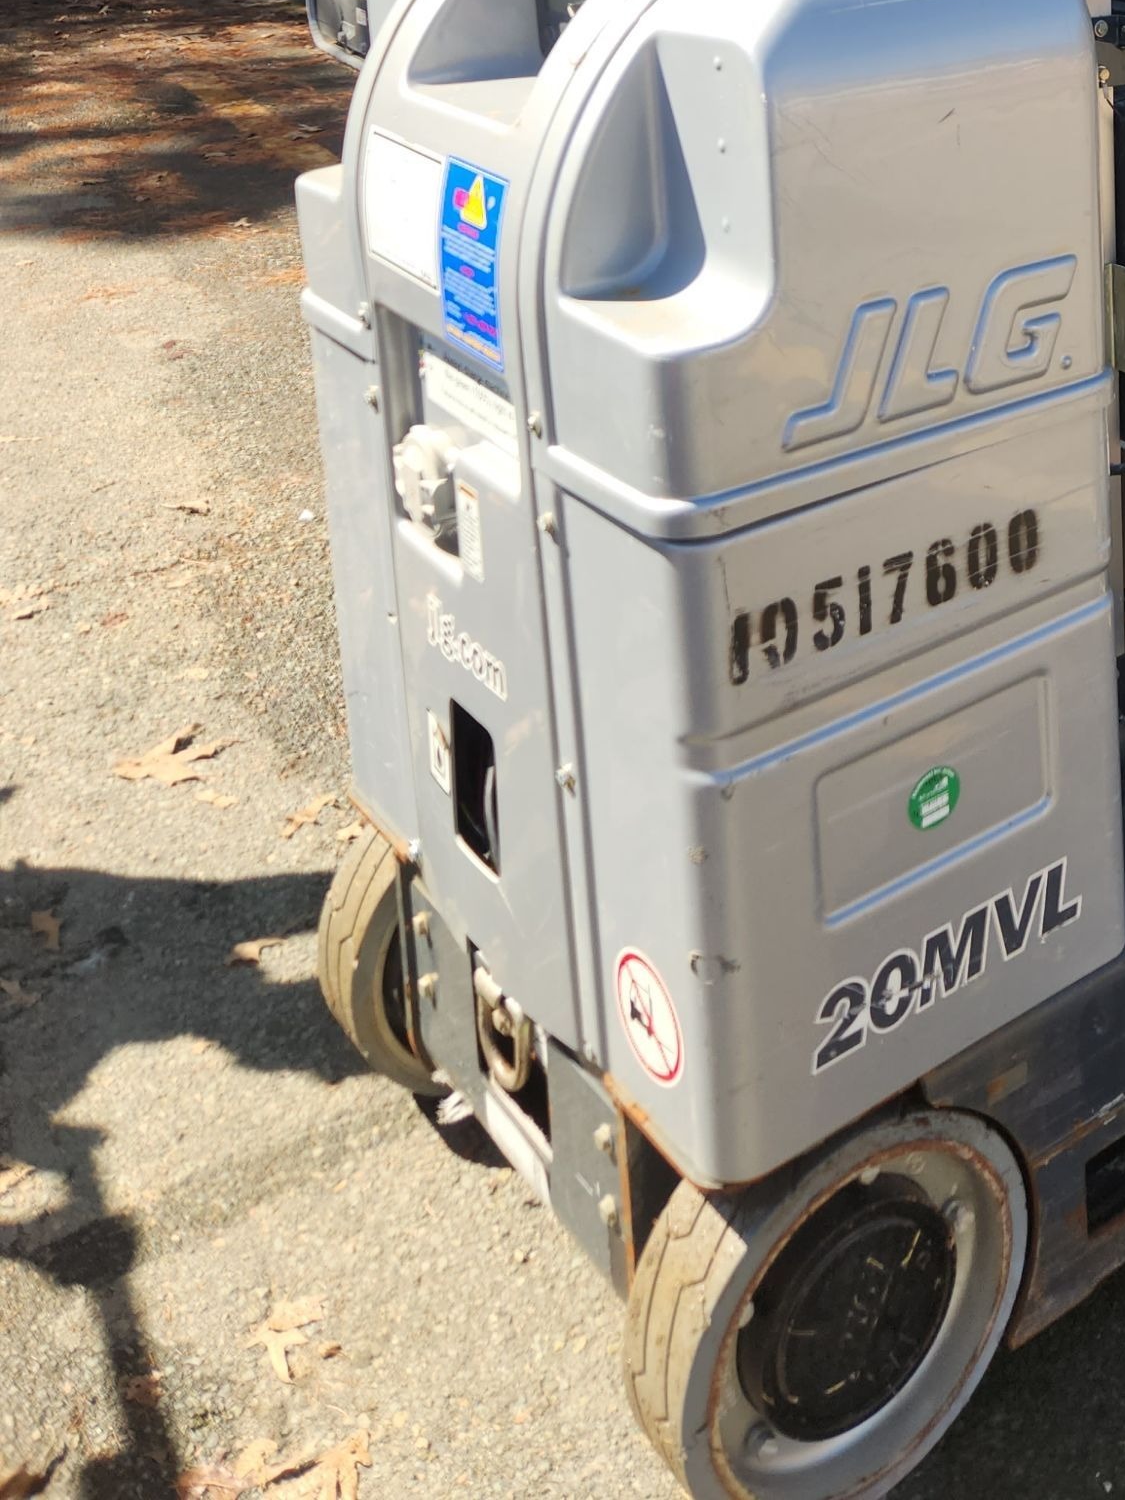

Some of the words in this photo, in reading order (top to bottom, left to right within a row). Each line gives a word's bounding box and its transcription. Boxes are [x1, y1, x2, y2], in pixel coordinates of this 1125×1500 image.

[781, 252, 1078, 453] JLG
[728, 507, 1040, 687] 10517600
[812, 855, 1083, 1075] 20MVL
